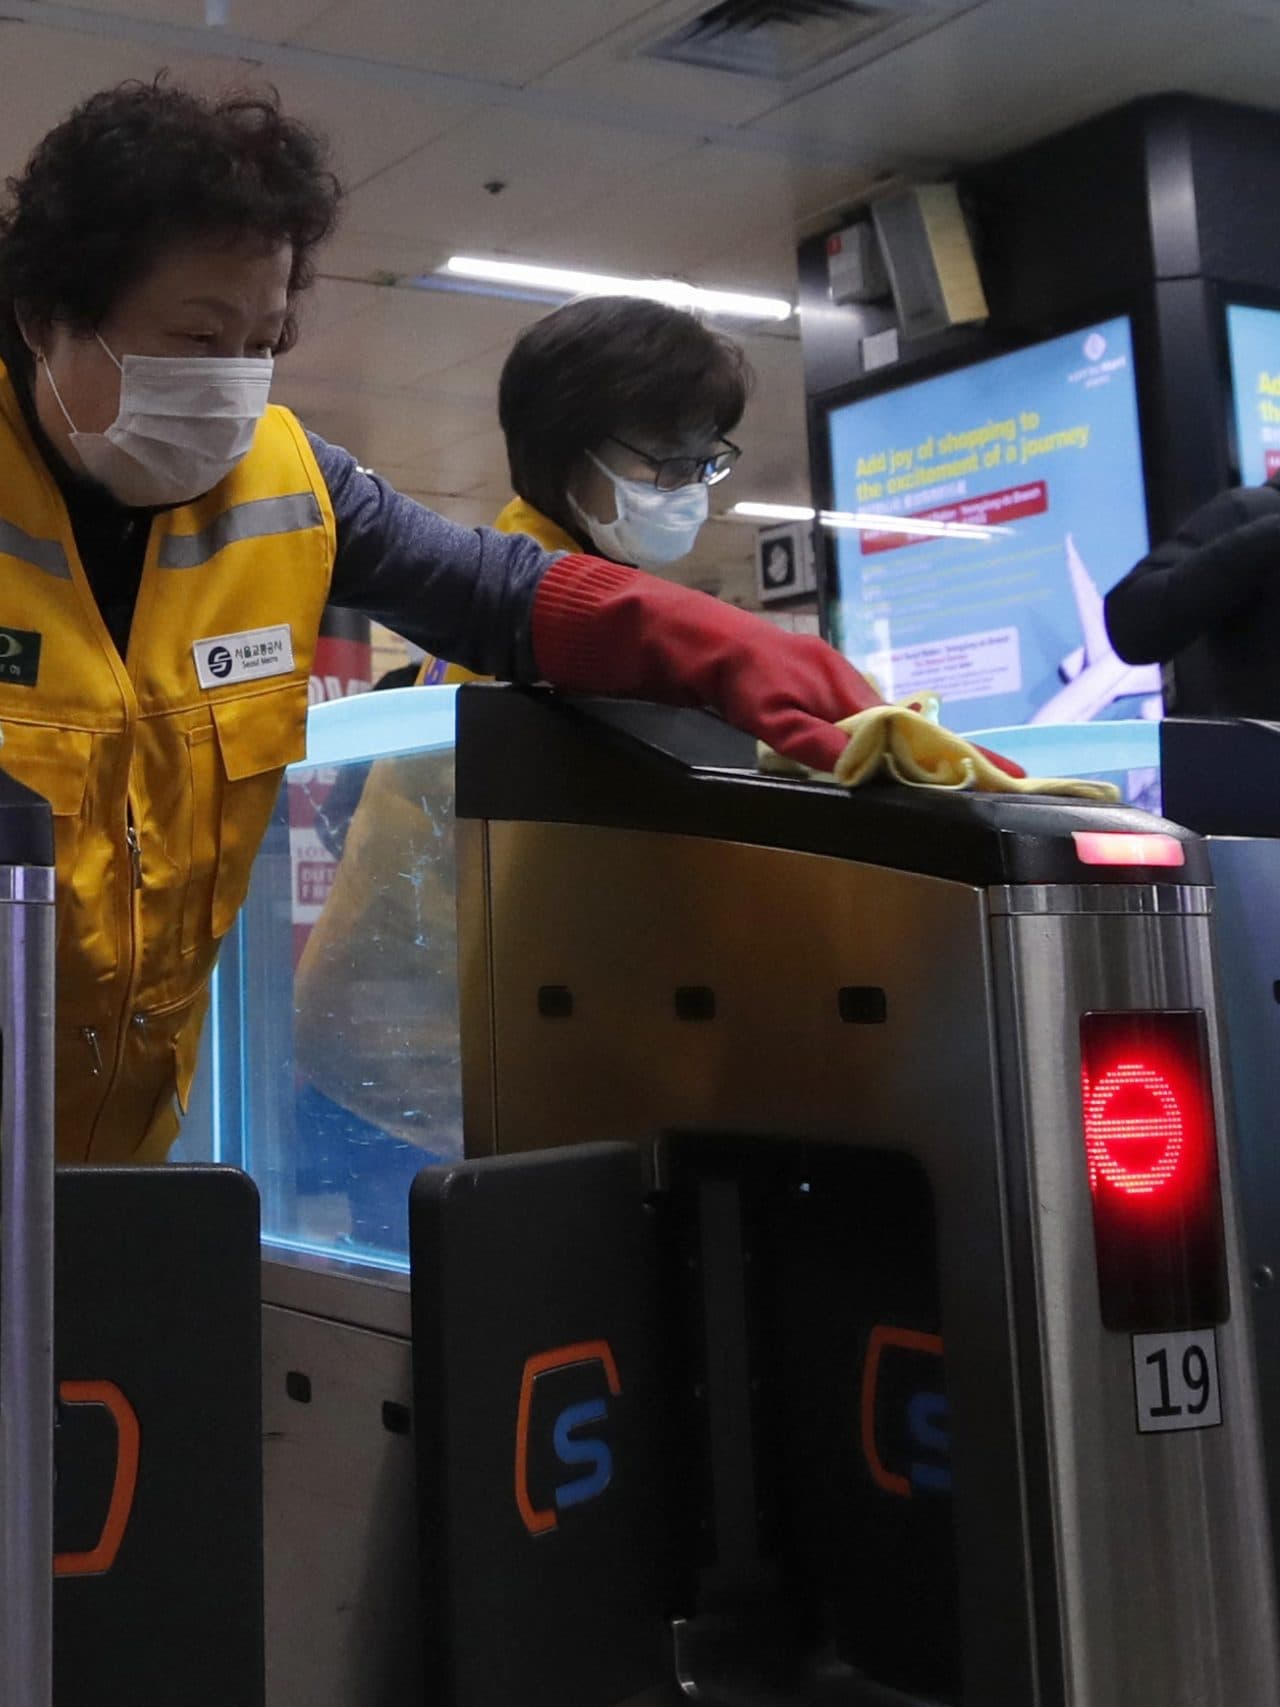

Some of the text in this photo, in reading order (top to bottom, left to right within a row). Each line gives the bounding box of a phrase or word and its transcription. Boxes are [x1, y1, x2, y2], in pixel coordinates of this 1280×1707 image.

[856, 411, 1040, 477] Add joy of shopping to
[856, 479, 883, 503] the
[983, 444, 1001, 468] of
[1019, 424, 1089, 464] journey
[235, 640, 283, 660] 서울교통공사
[1146, 1344, 1211, 1418] 19
